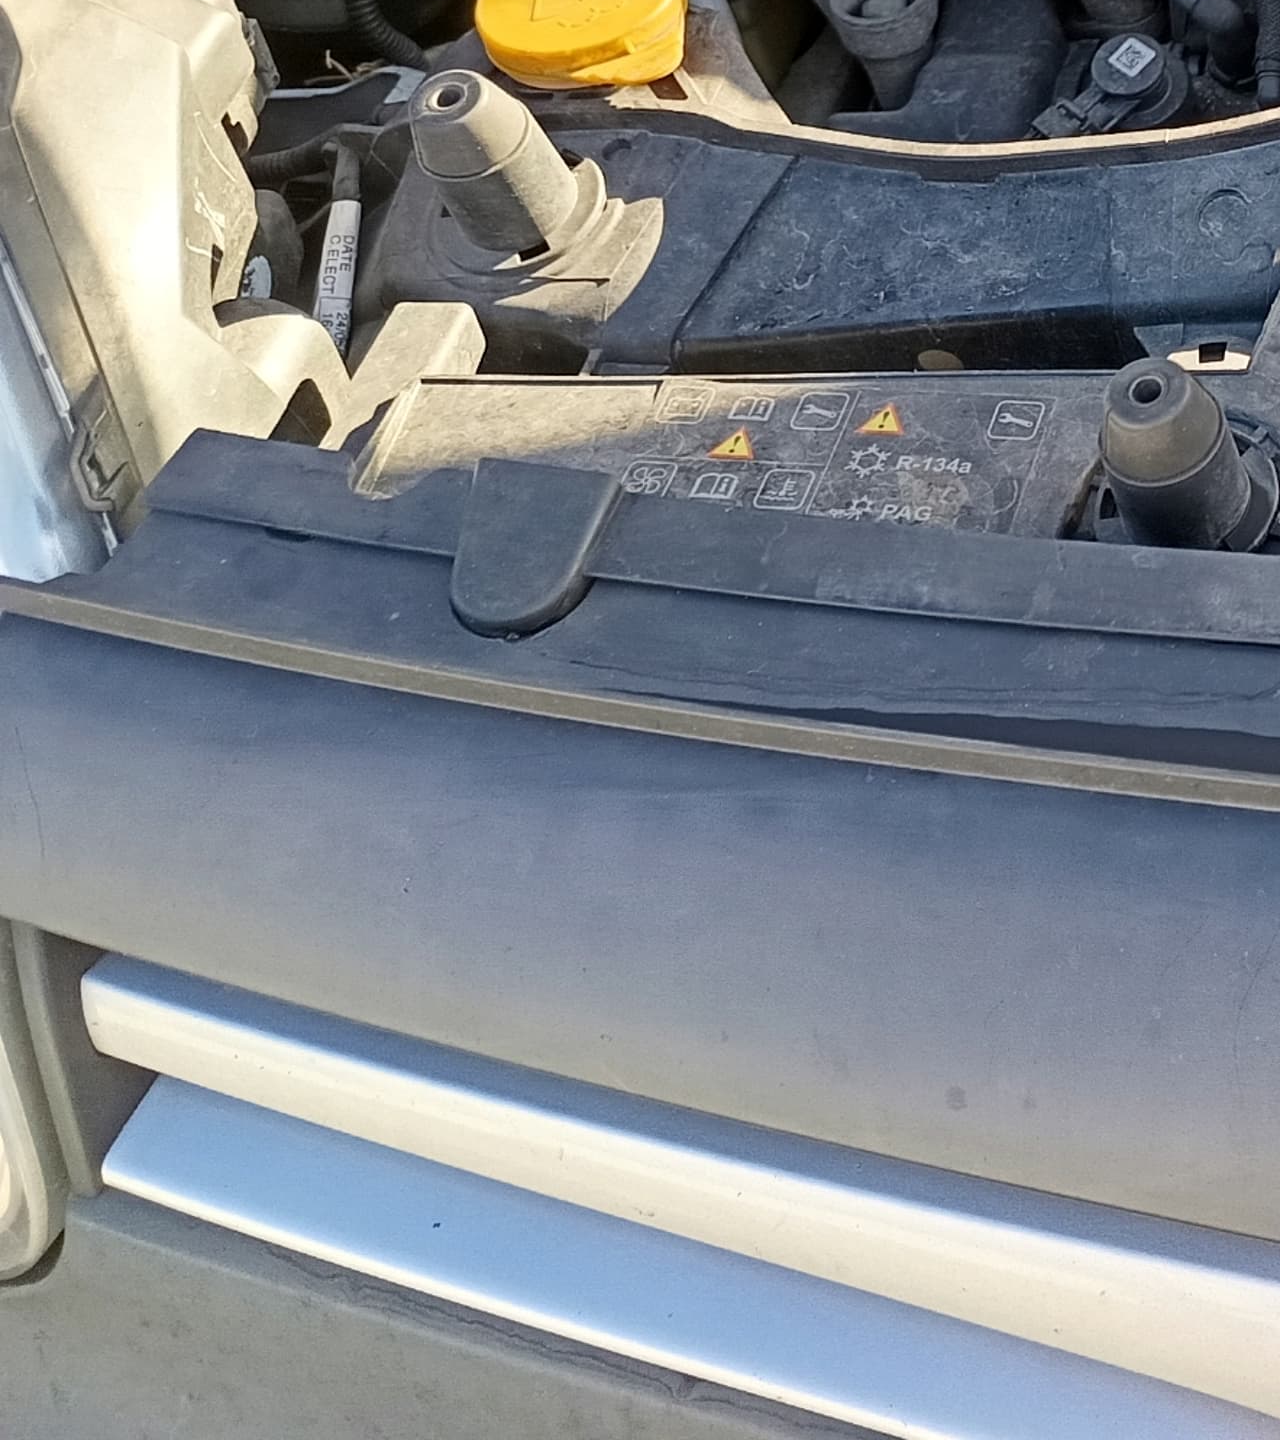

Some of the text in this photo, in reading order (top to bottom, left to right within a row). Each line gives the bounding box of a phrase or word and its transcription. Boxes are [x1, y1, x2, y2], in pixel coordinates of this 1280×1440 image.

[340, 235, 355, 272] DATE
[896, 456, 972, 474] R-134a
[880, 504, 932, 521] PAG
